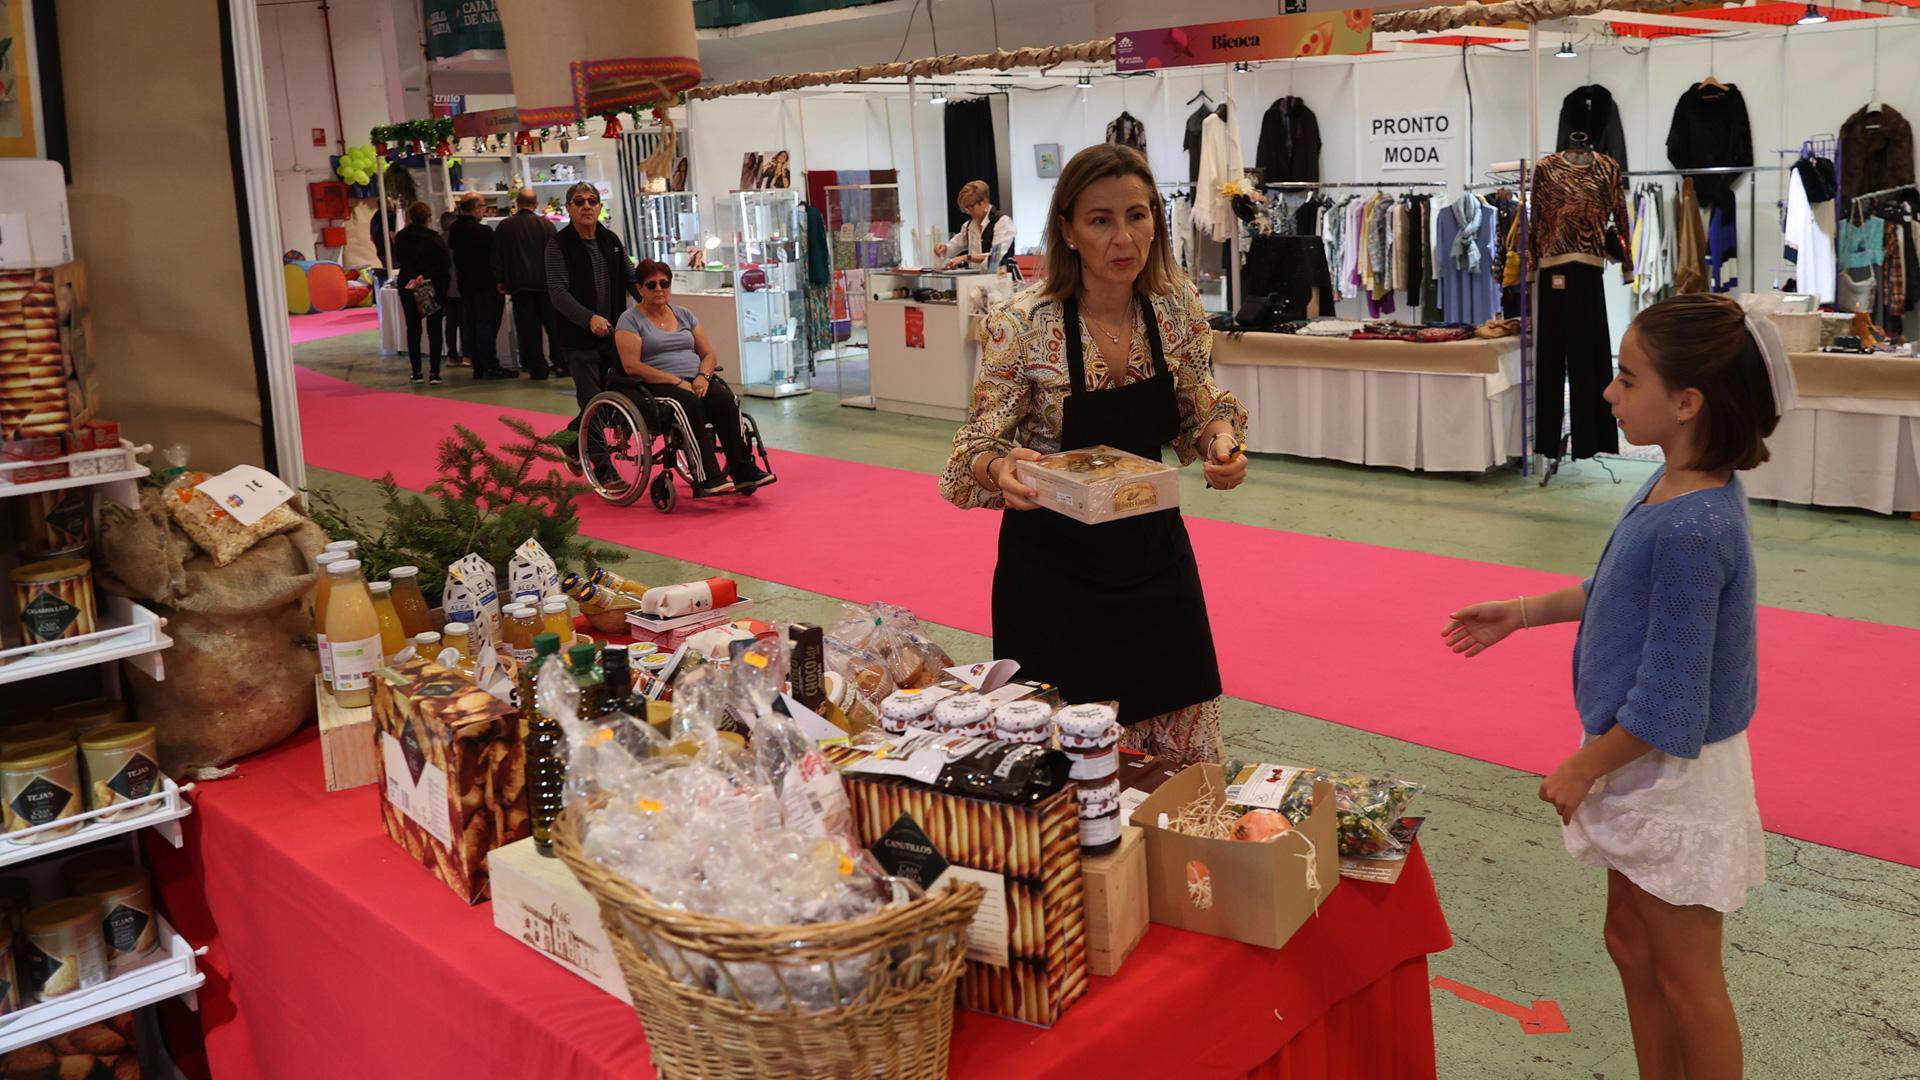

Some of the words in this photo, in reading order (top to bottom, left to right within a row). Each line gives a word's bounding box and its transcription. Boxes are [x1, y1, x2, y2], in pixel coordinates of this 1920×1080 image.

[464, 15, 480, 26] DE
[1212, 33, 1260, 50] Bicoca
[1372, 115, 1449, 135] PRONTO
[1384, 146, 1440, 163] MODA
[127, 766, 150, 778] TEJAS
[26, 790, 54, 802] TEJAS
